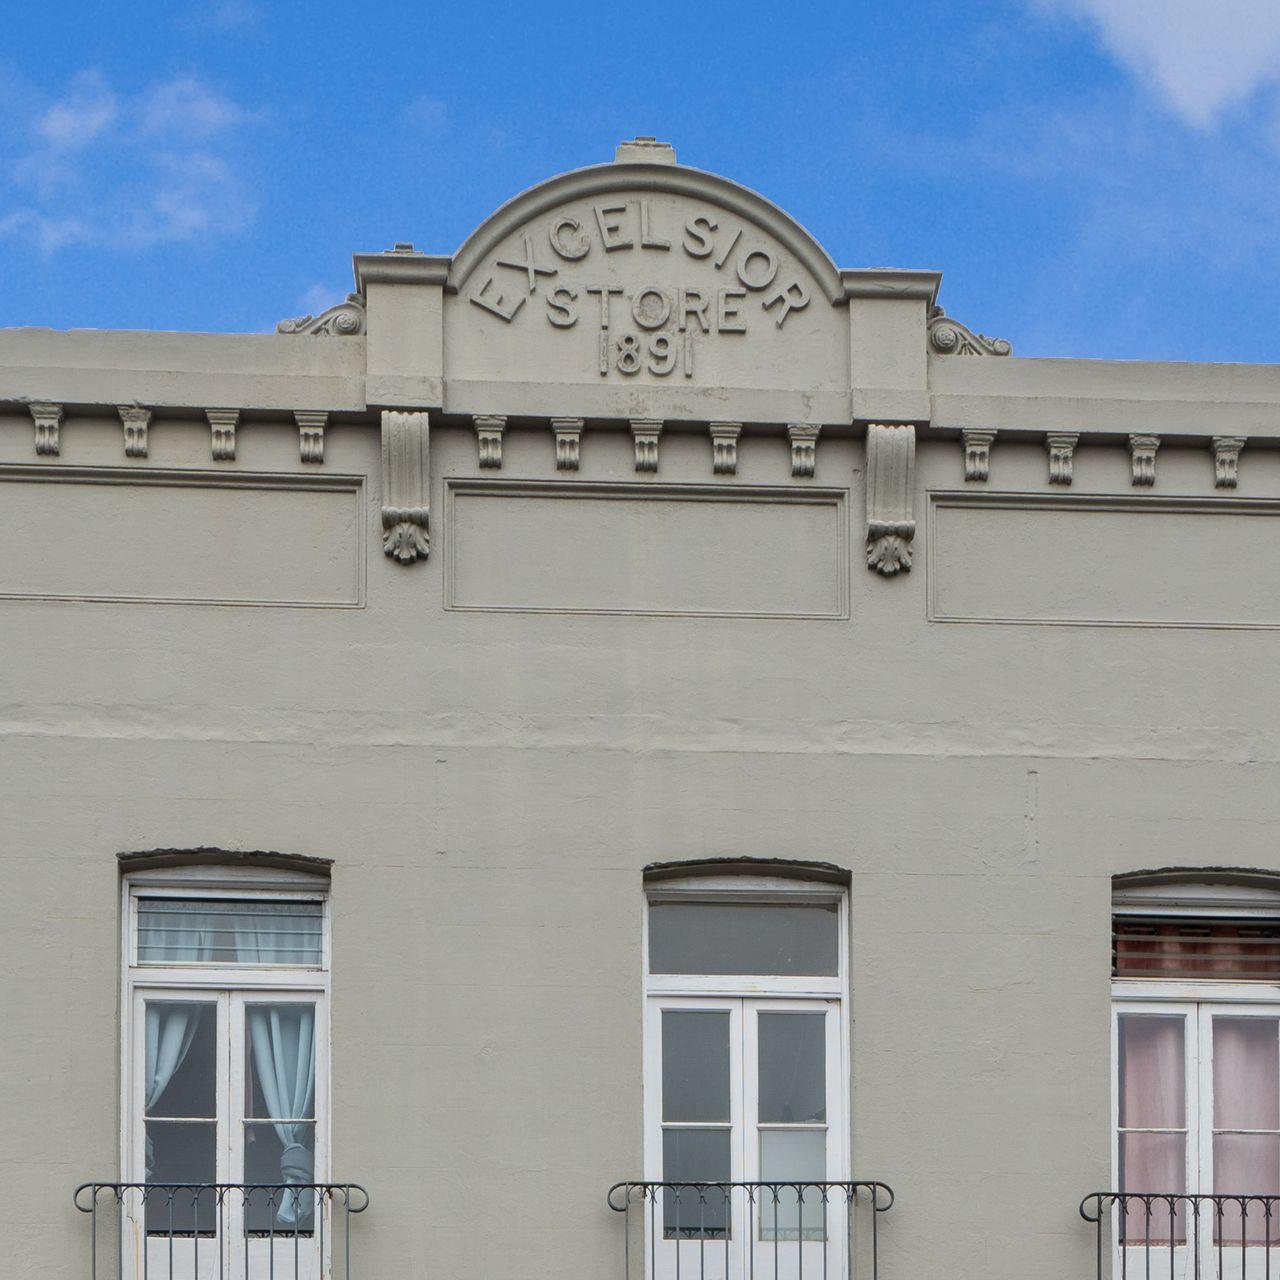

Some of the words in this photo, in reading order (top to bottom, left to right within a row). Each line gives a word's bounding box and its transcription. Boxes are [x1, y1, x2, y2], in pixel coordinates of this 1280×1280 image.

[469, 201, 811, 328] EXCELSIOR
[546, 286, 747, 335] STORE
[599, 330, 695, 379] 1891
